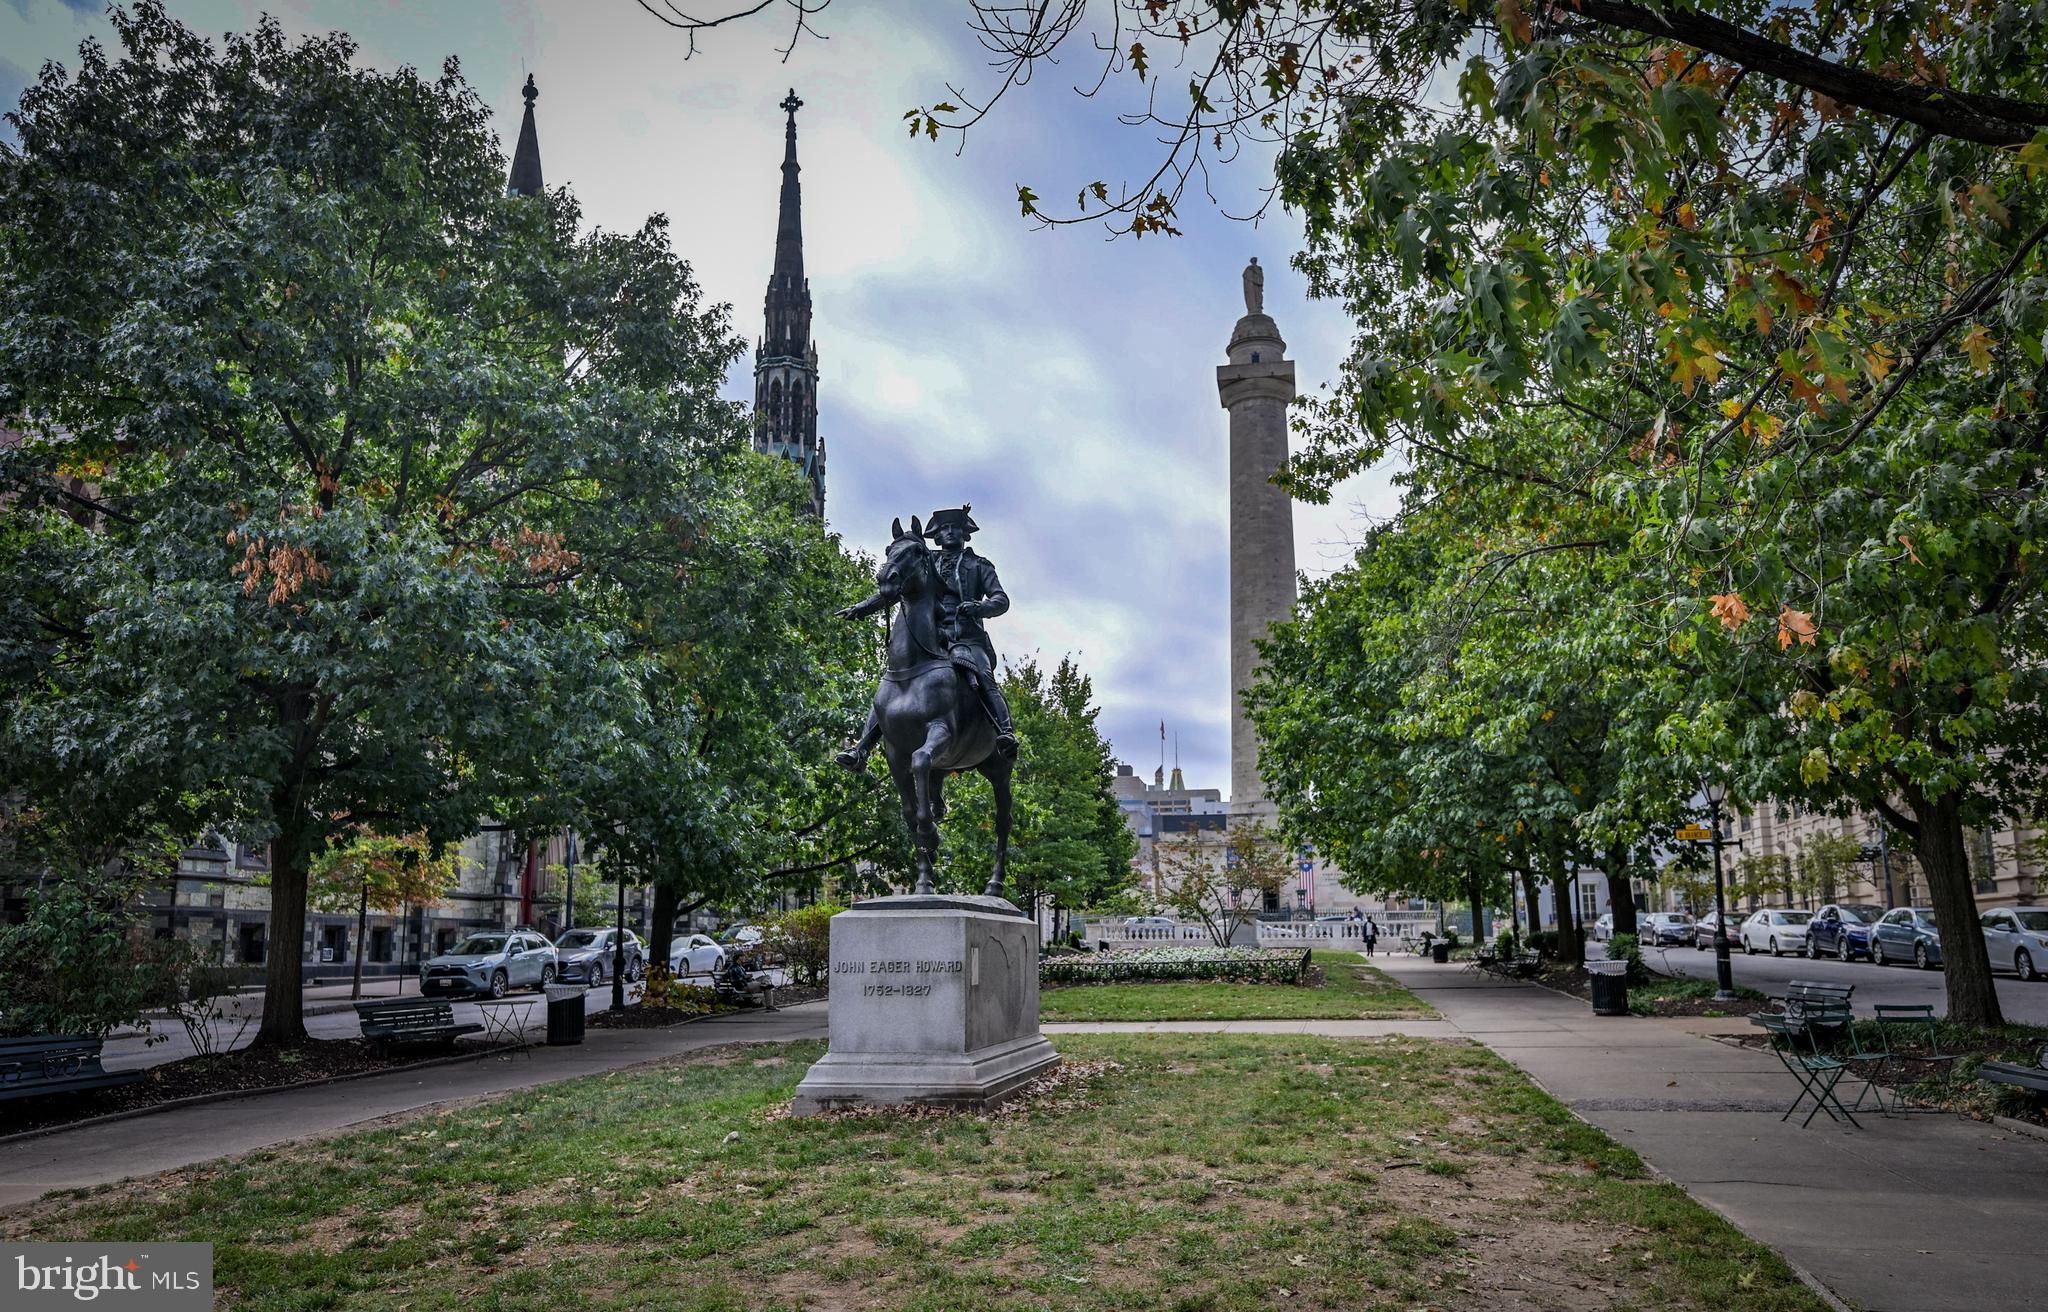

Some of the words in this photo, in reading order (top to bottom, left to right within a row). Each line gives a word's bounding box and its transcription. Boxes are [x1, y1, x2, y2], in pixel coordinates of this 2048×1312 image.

[833, 961, 865, 973] JOHN
[870, 961, 910, 973] EAGER
[915, 960, 963, 973] HOWARD
[863, 984, 931, 996] 1752-1827
